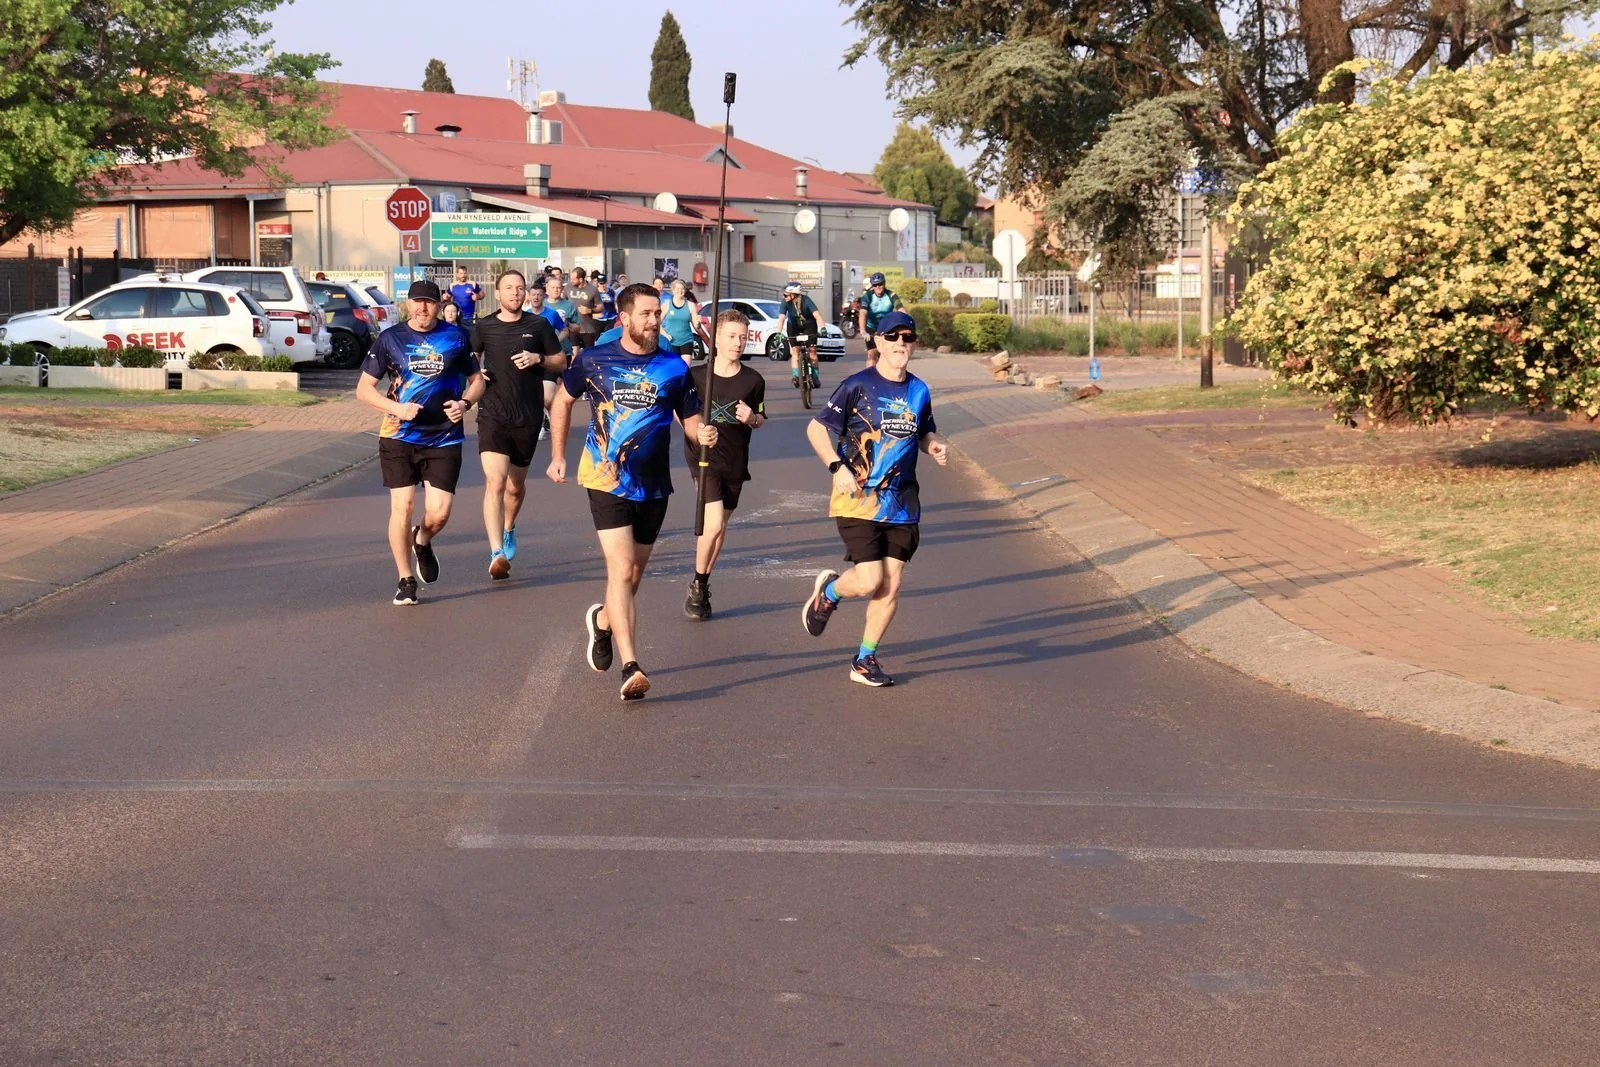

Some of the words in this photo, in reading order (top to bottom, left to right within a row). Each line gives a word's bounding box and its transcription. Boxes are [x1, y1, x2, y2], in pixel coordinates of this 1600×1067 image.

[389, 200, 427, 219] STOP
[472, 227, 507, 235] Waterkloof
[509, 227, 528, 237] Ridge
[406, 235, 416, 249] 4
[493, 245, 516, 254] Irene
[126, 331, 186, 349] SEEK
[612, 394, 656, 404] RYNEVELD
[642, 390, 658, 399] VAN
[881, 424, 918, 433] RYNEVELD
